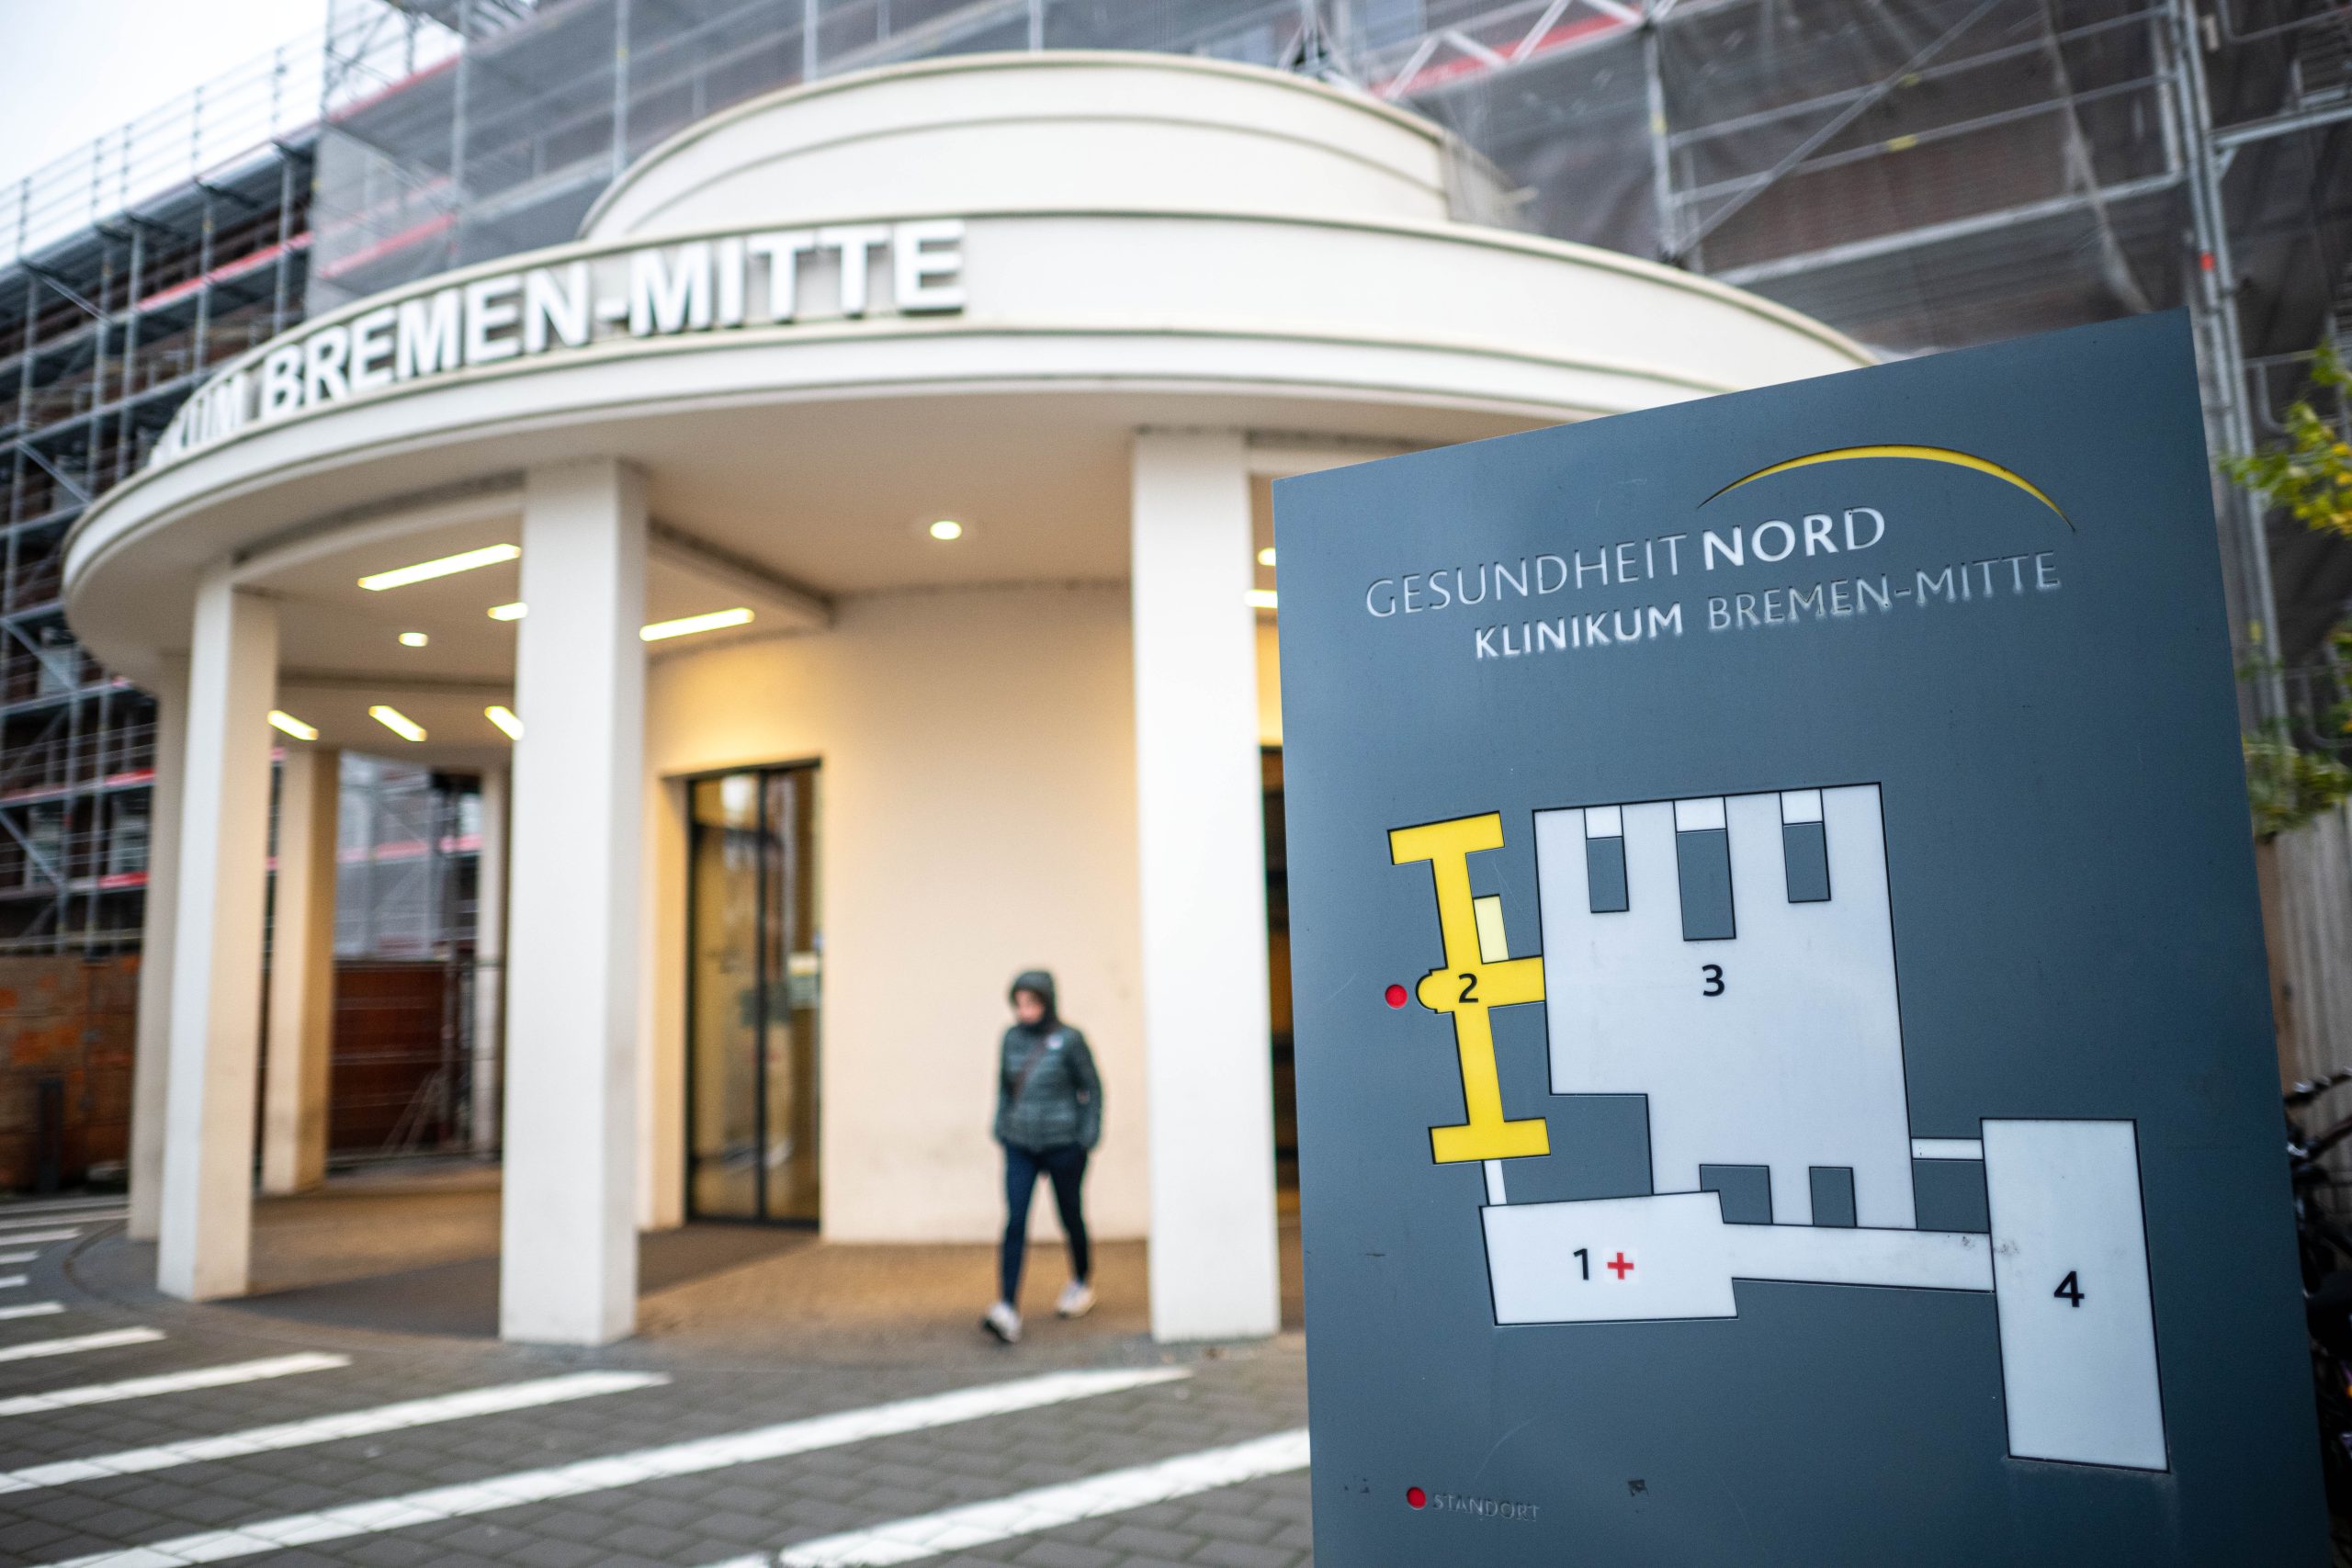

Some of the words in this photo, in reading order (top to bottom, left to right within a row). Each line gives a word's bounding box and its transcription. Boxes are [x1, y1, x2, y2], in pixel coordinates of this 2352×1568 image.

[260, 218, 967, 419] BREMEN-MITTE
[1365, 534, 1687, 619] GESUNDHEIT
[1702, 506, 1887, 571] NORD
[1474, 602, 1684, 660] KLINIKUM
[1707, 551, 2062, 631] BREMEN-MITTE
[1457, 974, 1480, 1004] 2
[1701, 964, 1726, 998] 3
[1572, 1247, 1590, 1281] 1
[2053, 1269, 2086, 1308] 4
[1431, 1492, 1541, 1522] STANDORT
